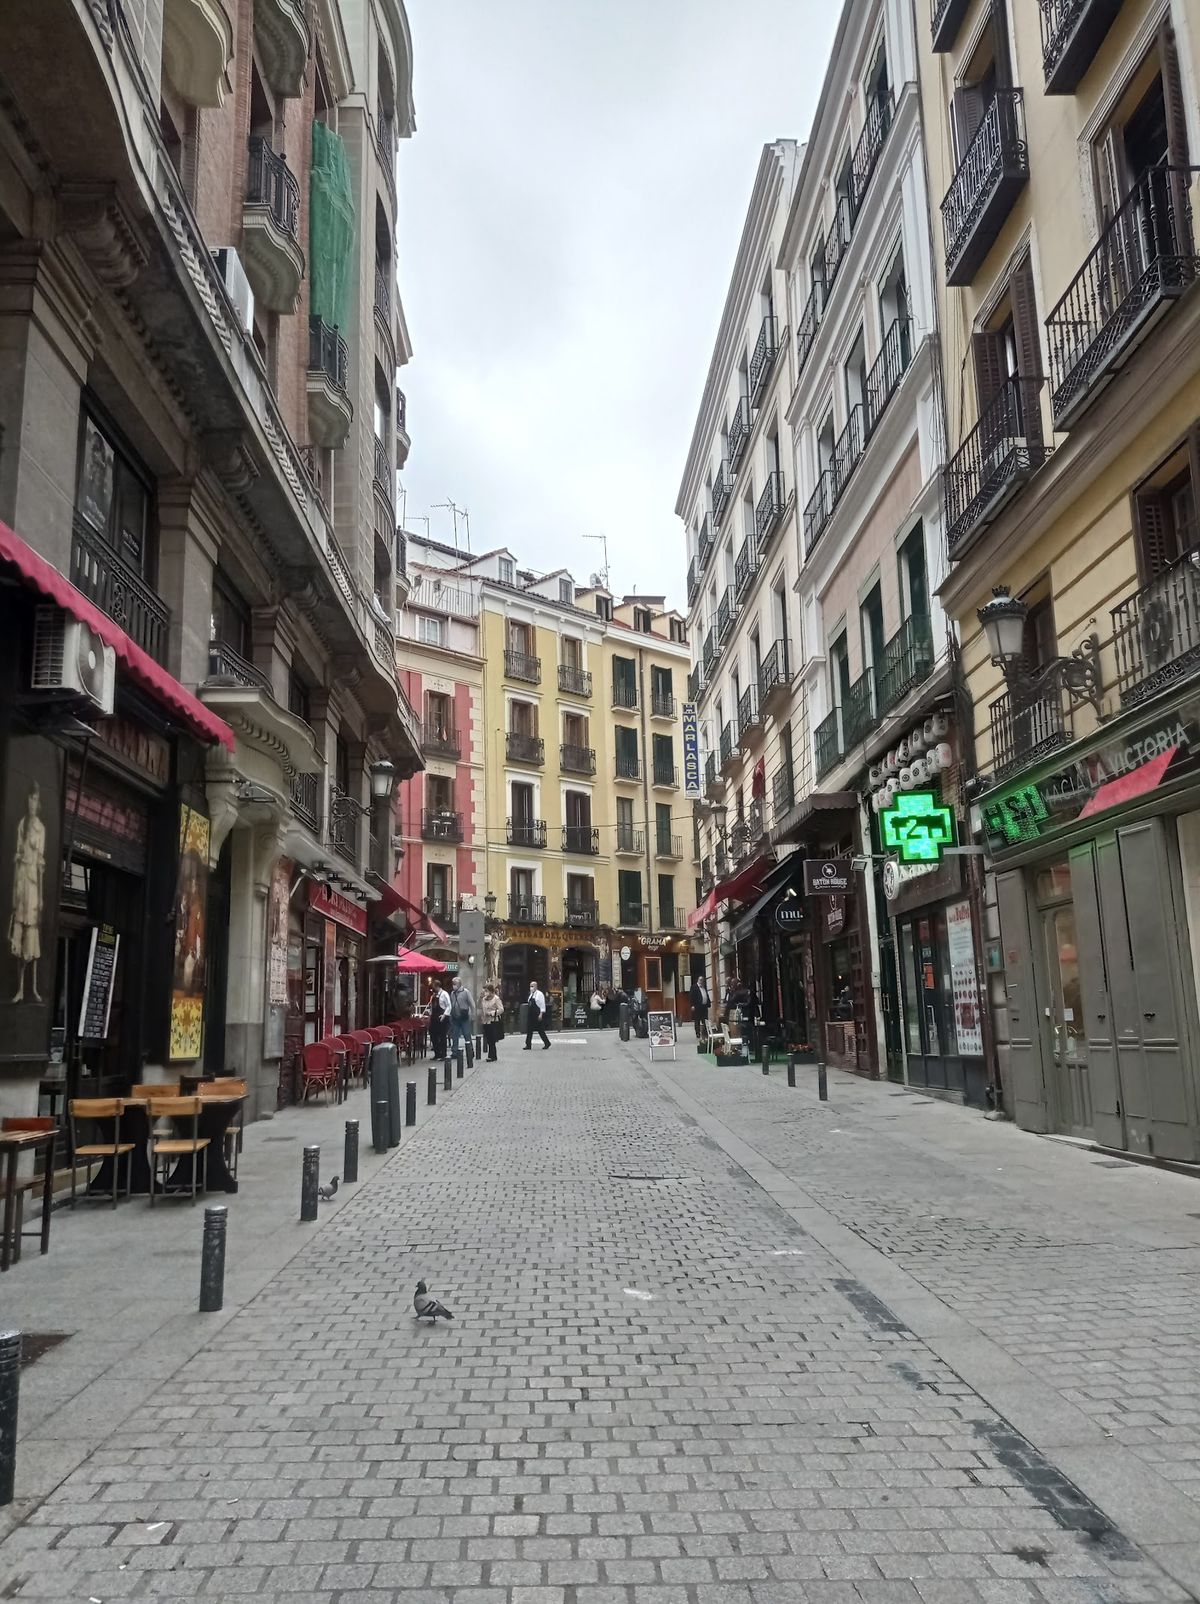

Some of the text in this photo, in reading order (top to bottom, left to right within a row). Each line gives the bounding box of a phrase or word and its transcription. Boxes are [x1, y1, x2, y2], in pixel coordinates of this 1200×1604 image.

[683, 715, 699, 789] MARLASCA
[1087, 763, 1108, 788] LA
[1109, 722, 1190, 777] VICTORIA
[831, 878, 848, 886] ROUGE
[640, 937, 667, 947] GRAMA
